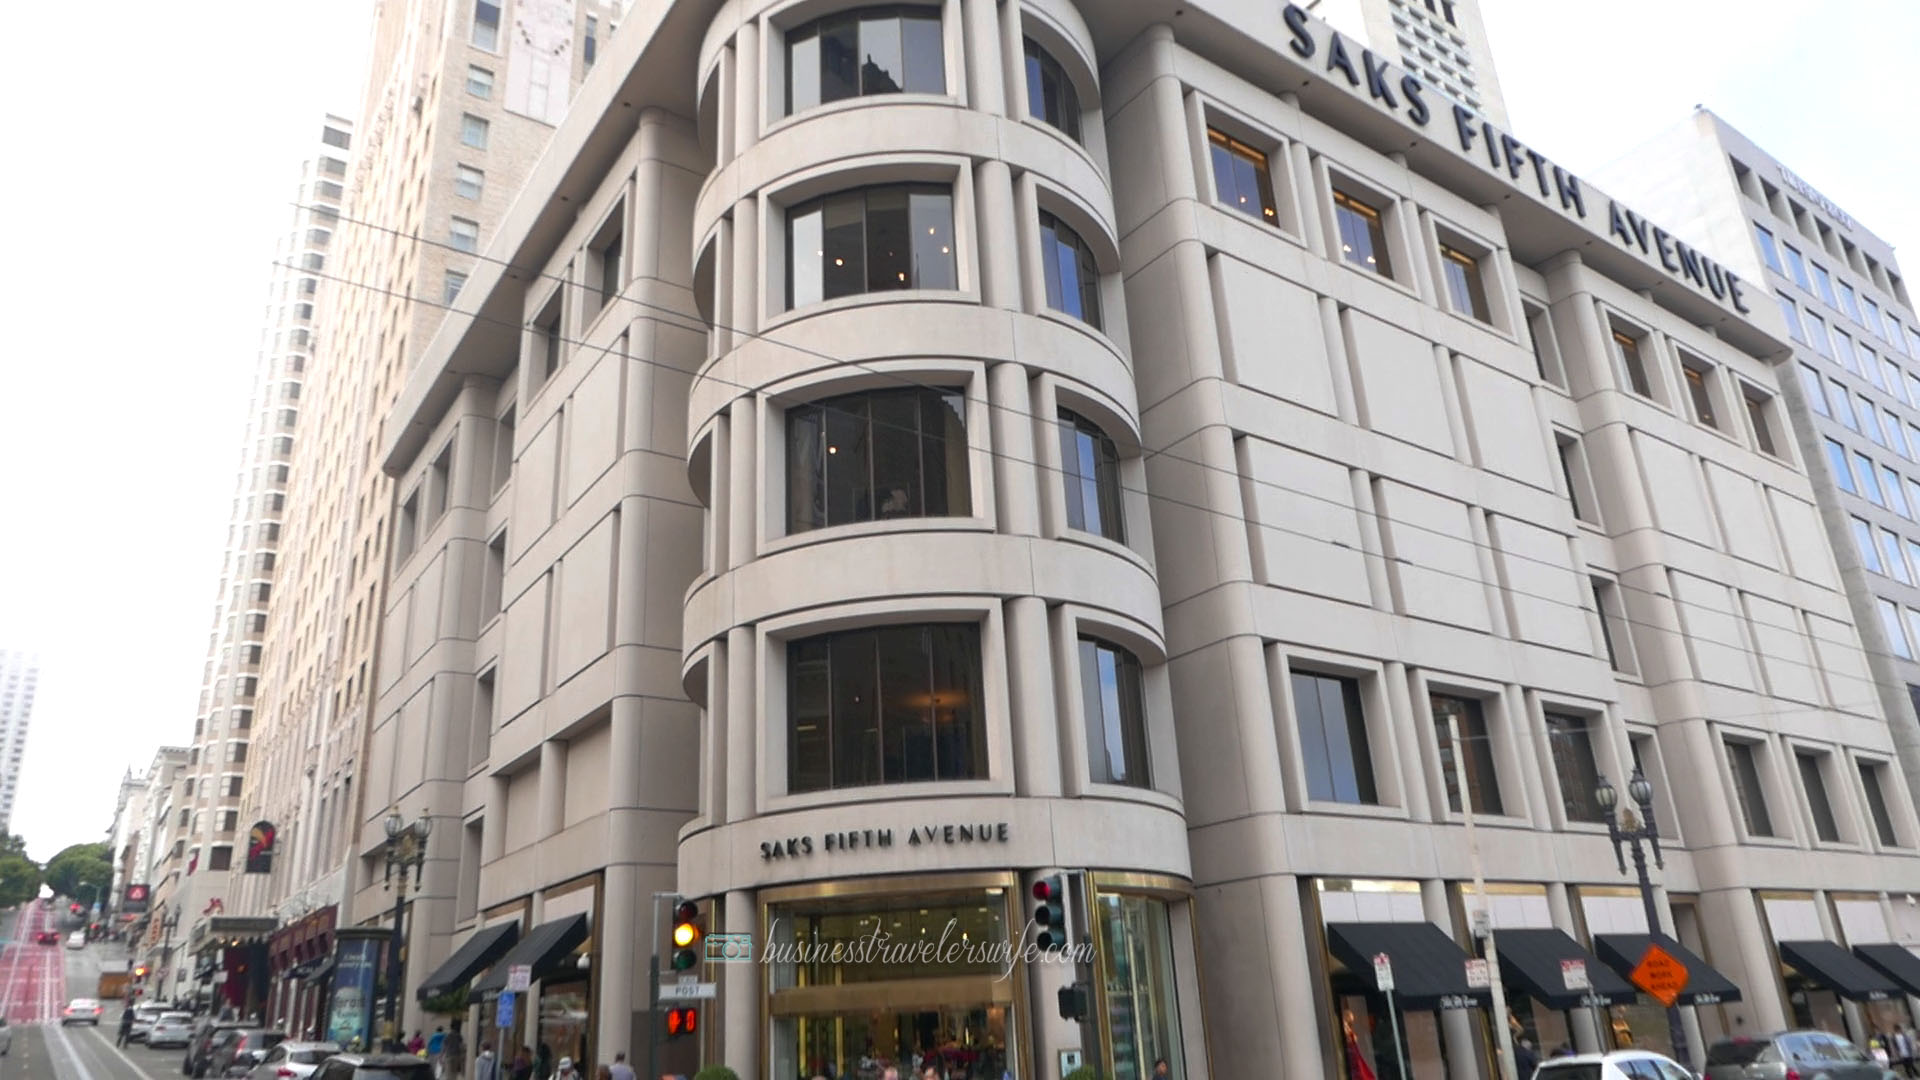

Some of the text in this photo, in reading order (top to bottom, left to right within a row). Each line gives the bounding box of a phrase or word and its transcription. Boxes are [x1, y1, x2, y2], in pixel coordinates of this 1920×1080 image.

[1283, 3, 1750, 314] SAKS FIFTH AVENUE
[760, 823, 1009, 861] SAKS FIFTH AVENUE
[675, 986, 700, 995] POST
